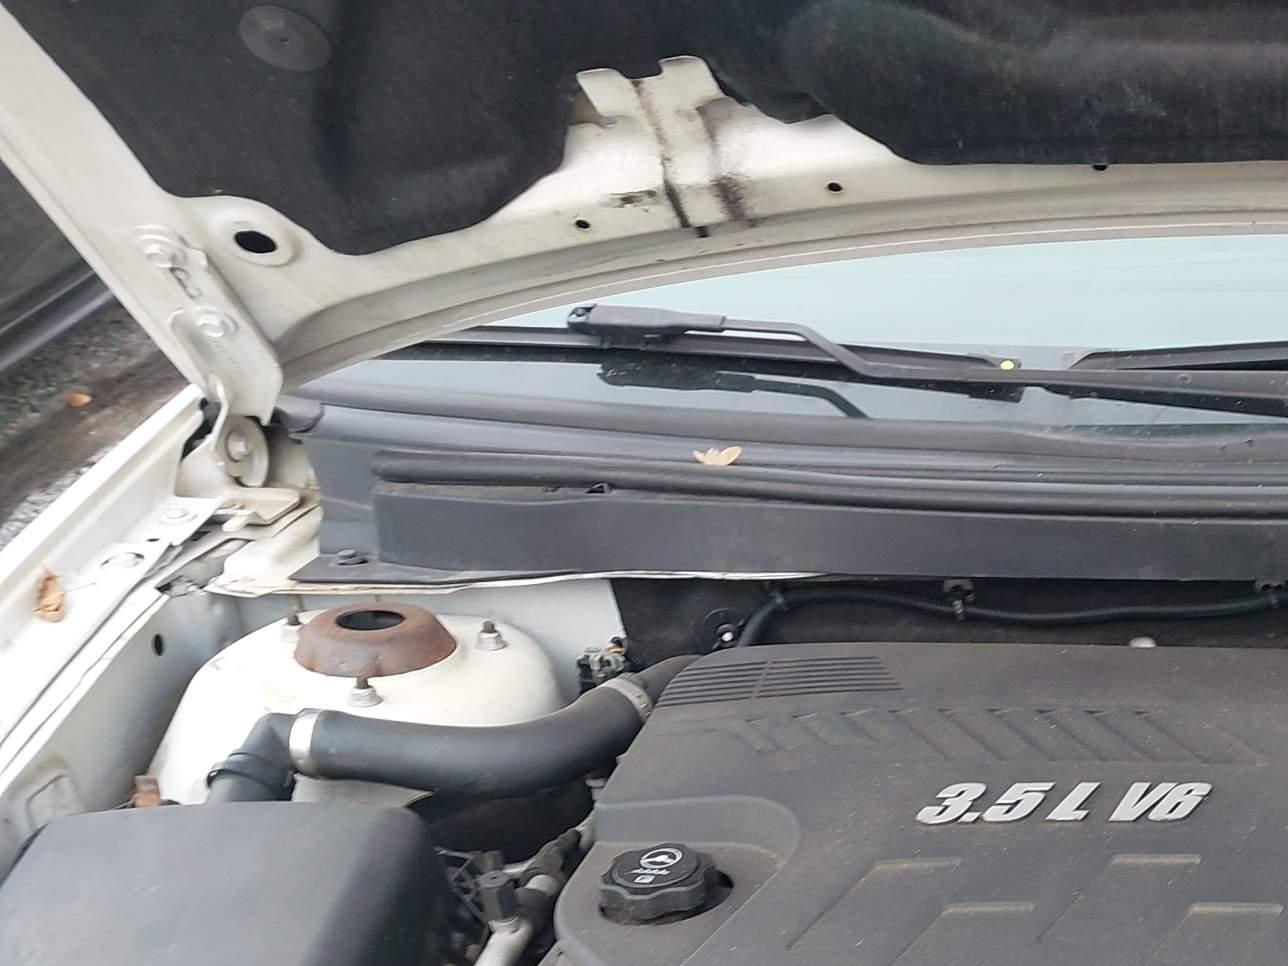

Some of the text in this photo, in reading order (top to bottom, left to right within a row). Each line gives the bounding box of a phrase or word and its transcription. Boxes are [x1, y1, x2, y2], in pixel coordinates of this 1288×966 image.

[915, 781, 1213, 825] 3.5 L V6
